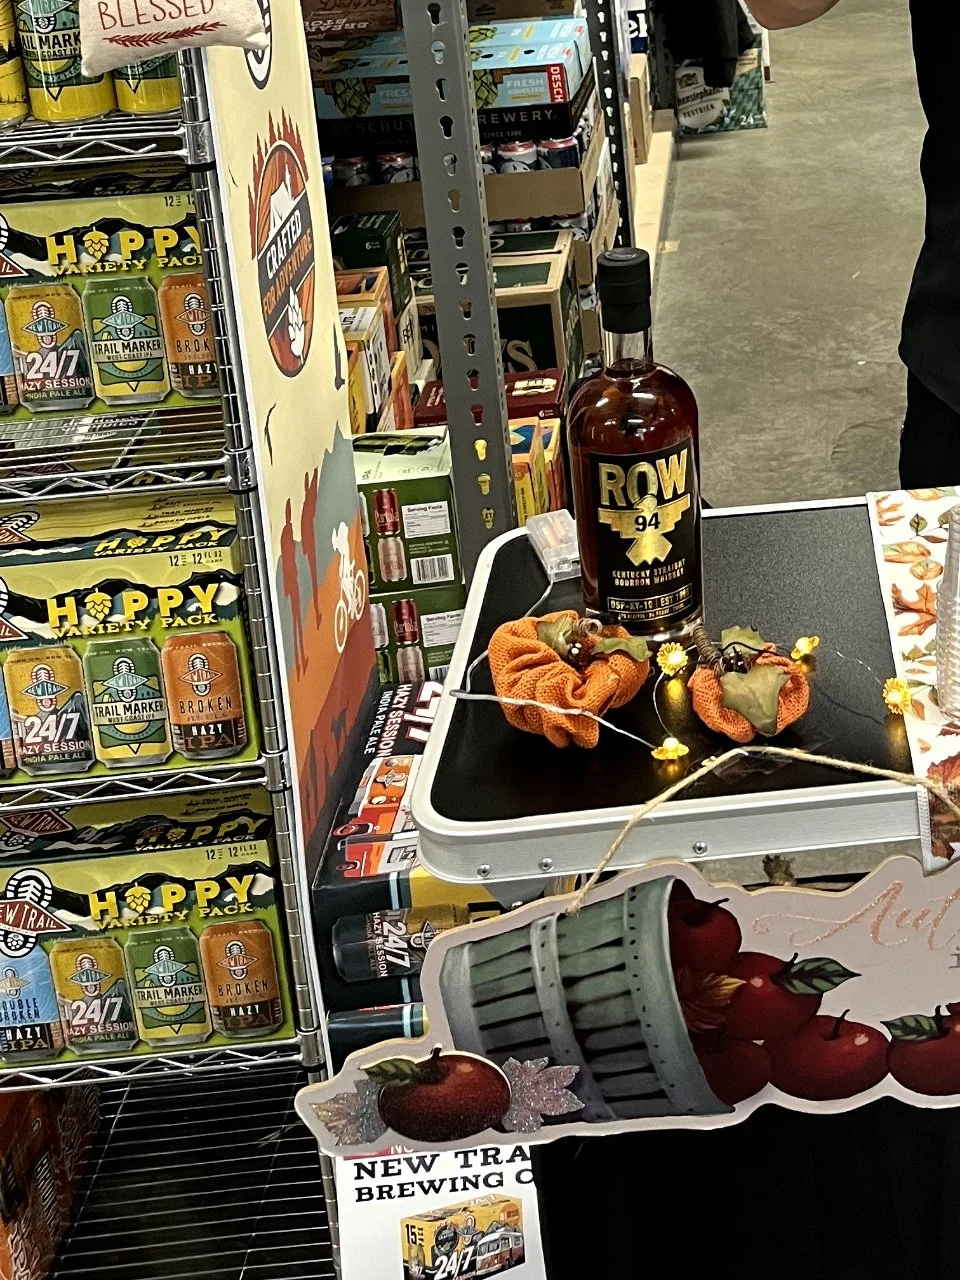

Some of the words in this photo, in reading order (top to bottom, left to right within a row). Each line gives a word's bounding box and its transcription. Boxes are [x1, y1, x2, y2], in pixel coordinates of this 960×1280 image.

[507, 77, 544, 88] FRESH
[550, 66, 562, 103] DESCH
[265, 212, 302, 280] CRAFTED
[263, 285, 277, 320] FOR
[275, 228, 312, 301] ADVENTURE
[94, 342, 119, 355] TRAIL
[121, 339, 161, 353] MARKER
[26, 350, 80, 379] 24/7
[598, 448, 688, 507] ROW
[635, 512, 661, 532] 94
[47, 583, 220, 628] HOPPY
[56, 620, 151, 638] VARIETY
[162, 613, 218, 628] PACK
[95, 704, 120, 717] TRAIL
[123, 700, 164, 715] MARKER
[179, 696, 232, 715] BROKEN
[377, 690, 393, 720] INDIA
[393, 684, 412, 711] HAZY
[24, 712, 81, 744] 24/7
[191, 724, 223, 736] HAZY
[370, 719, 384, 740] PALE
[378, 710, 401, 761] SESSION
[364, 738, 375, 754] ALE
[89, 874, 254, 920] HOPPY
[99, 910, 188, 930] VARIETY
[198, 901, 253, 918] PACK
[137, 989, 162, 1001] TRAIL
[164, 986, 203, 999] MARKER
[217, 979, 269, 996] BROKEN
[72, 997, 123, 1026] 24/7
[230, 1005, 260, 1017] HAZY
[10, 1038, 49, 1051] IPA
[354, 1154, 440, 1180] NEW
[355, 1171, 503, 1202] BREWING
[406, 1224, 417, 1245] 15
